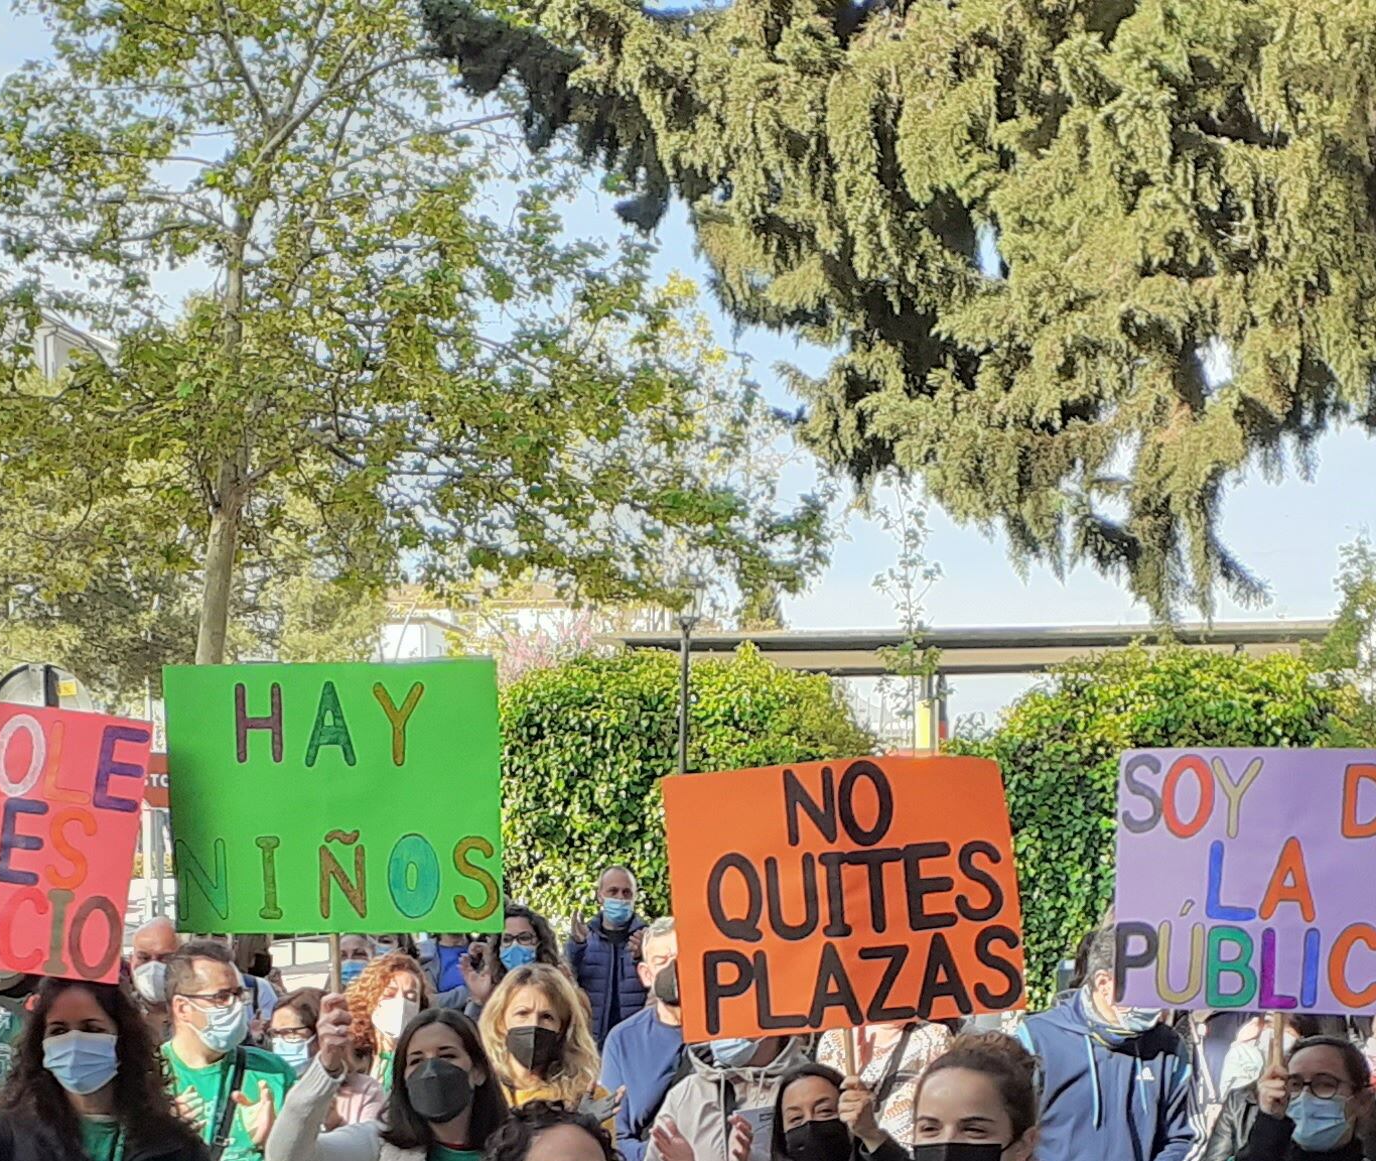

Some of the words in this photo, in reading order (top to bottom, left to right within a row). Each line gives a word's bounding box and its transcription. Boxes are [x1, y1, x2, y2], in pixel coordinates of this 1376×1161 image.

[234, 680, 425, 768] HAY
[782, 759, 894, 846] NO
[1121, 753, 1263, 840] SOY
[173, 828, 500, 922] NIÑOS
[707, 839, 1004, 942] QUITES
[1207, 836, 1317, 923] LA
[702, 925, 1022, 1036] PLAZAS
